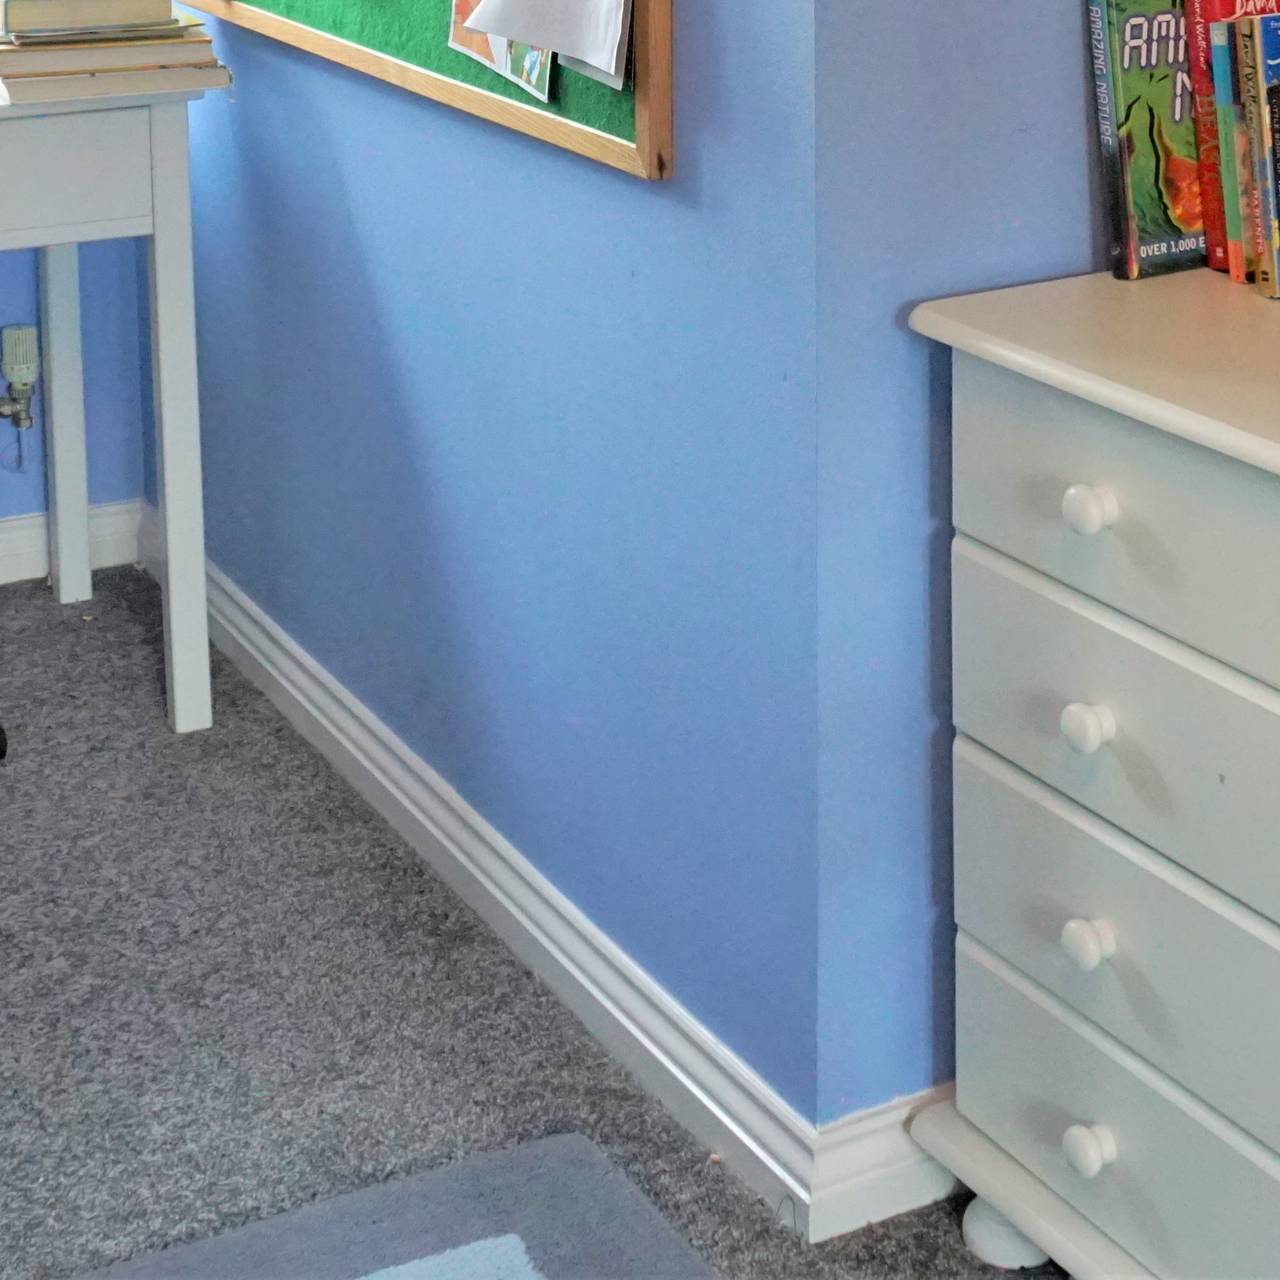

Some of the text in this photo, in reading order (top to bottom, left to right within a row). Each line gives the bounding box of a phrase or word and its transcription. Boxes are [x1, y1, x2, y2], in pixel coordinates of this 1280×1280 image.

[1089, 5, 1107, 74] AMAZING
[1195, 22, 1208, 70] Walliams
[1095, 80, 1112, 146] NATURE
[1140, 238, 1168, 259] OVER
[1170, 239, 1197, 254] 1,000
[1252, 189, 1265, 254] PARENTS
